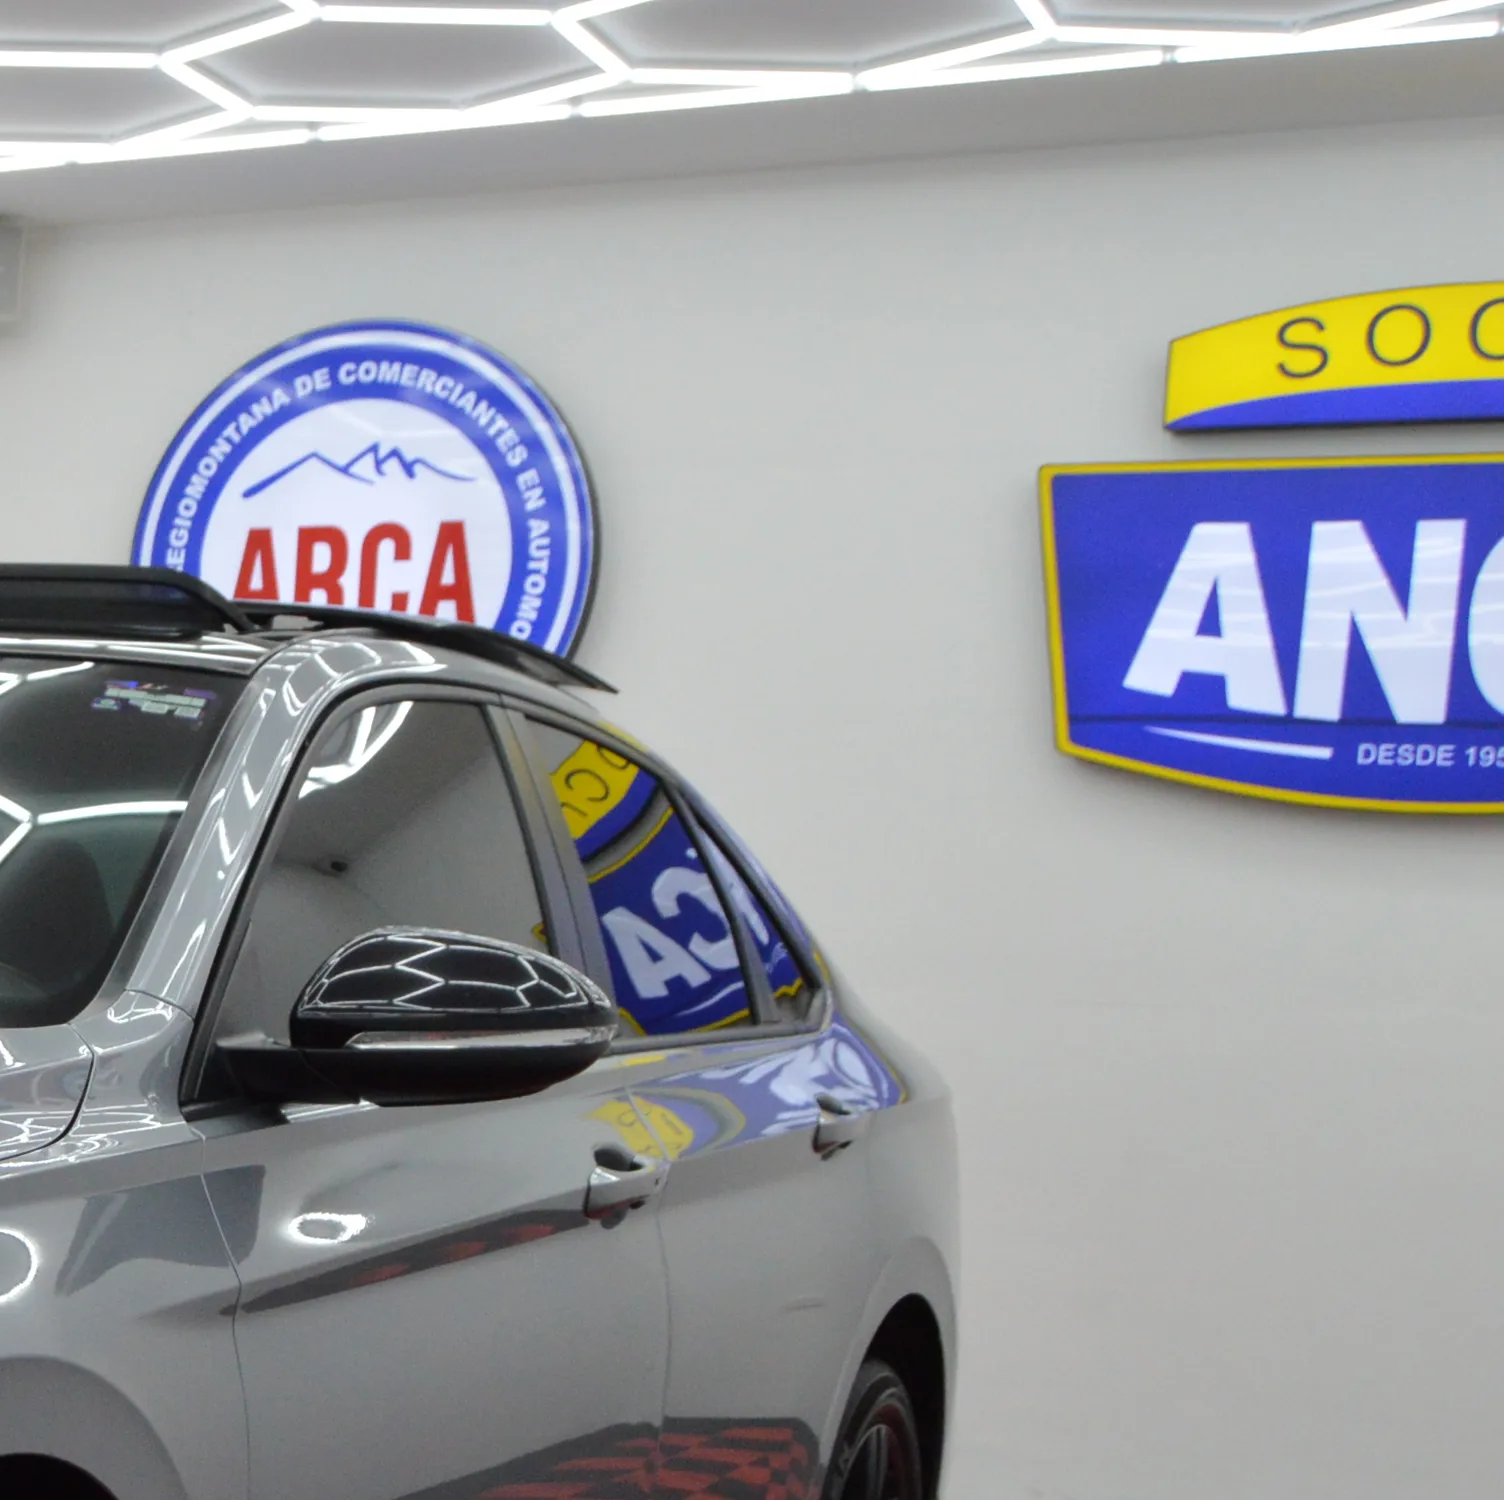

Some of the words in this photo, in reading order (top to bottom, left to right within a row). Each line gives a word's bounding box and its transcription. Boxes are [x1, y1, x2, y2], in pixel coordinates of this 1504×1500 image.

[294, 366, 332, 399] DE
[337, 360, 527, 466] COMERCIANTES
[516, 468, 546, 513] EN
[232, 520, 477, 624] ARCA
[1356, 742, 1456, 767] DESDE
